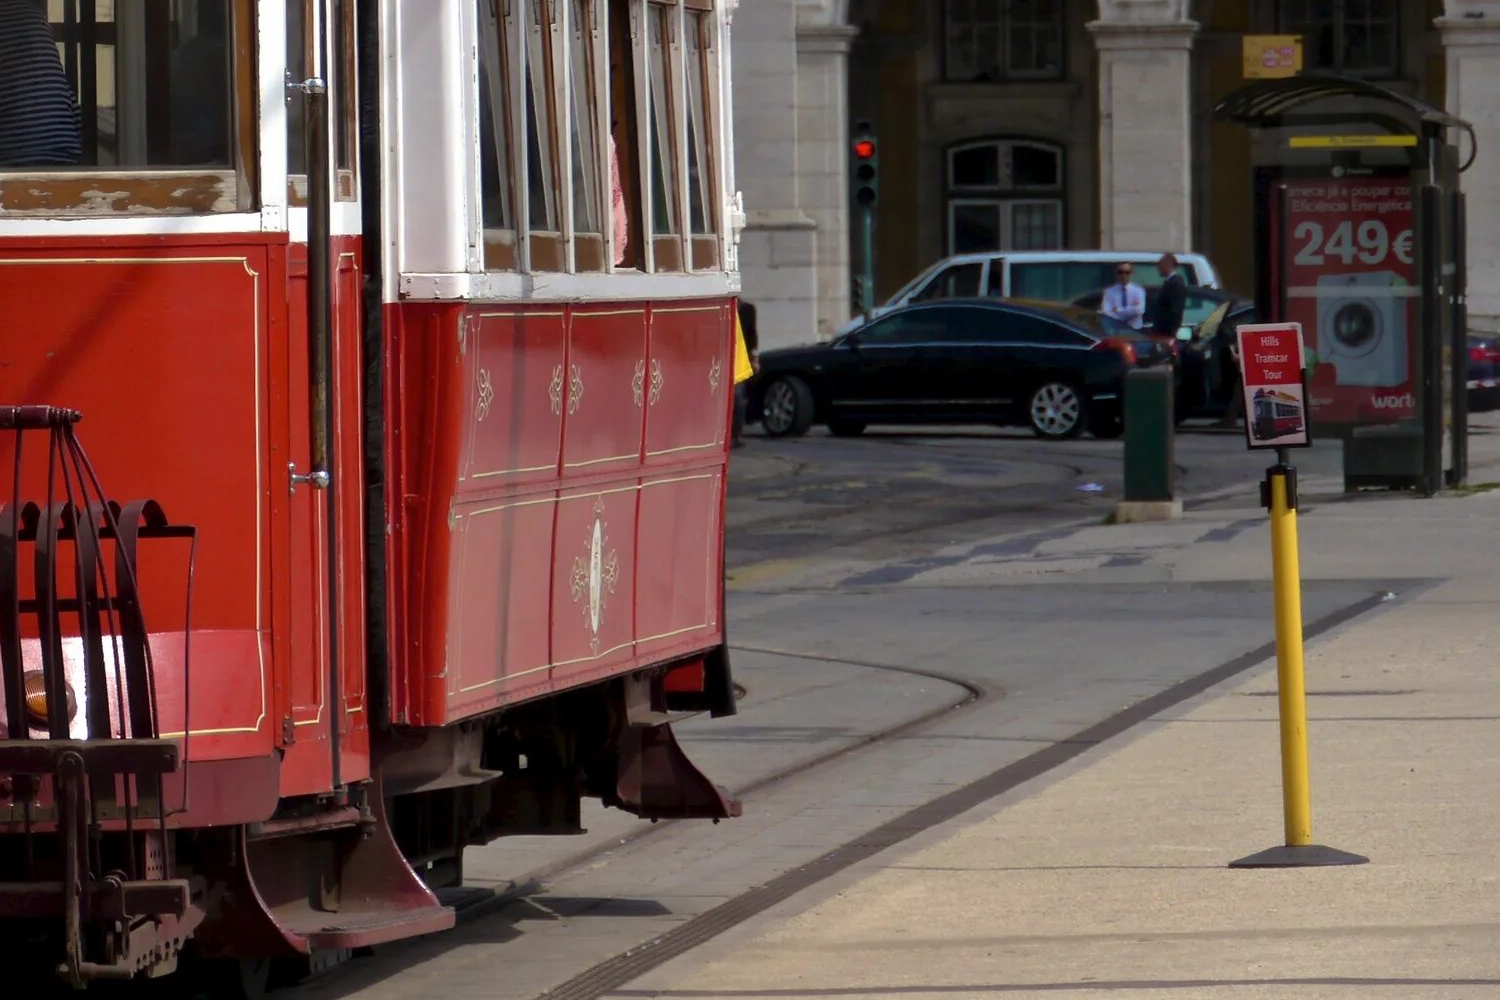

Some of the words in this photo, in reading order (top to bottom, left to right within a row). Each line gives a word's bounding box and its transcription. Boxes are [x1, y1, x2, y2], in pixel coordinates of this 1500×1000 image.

[1351, 187, 1391, 199] poupar
[1260, 336, 1280, 347] Hills
[1254, 353, 1289, 364] Tramcar
[1262, 369, 1284, 380] Tour
